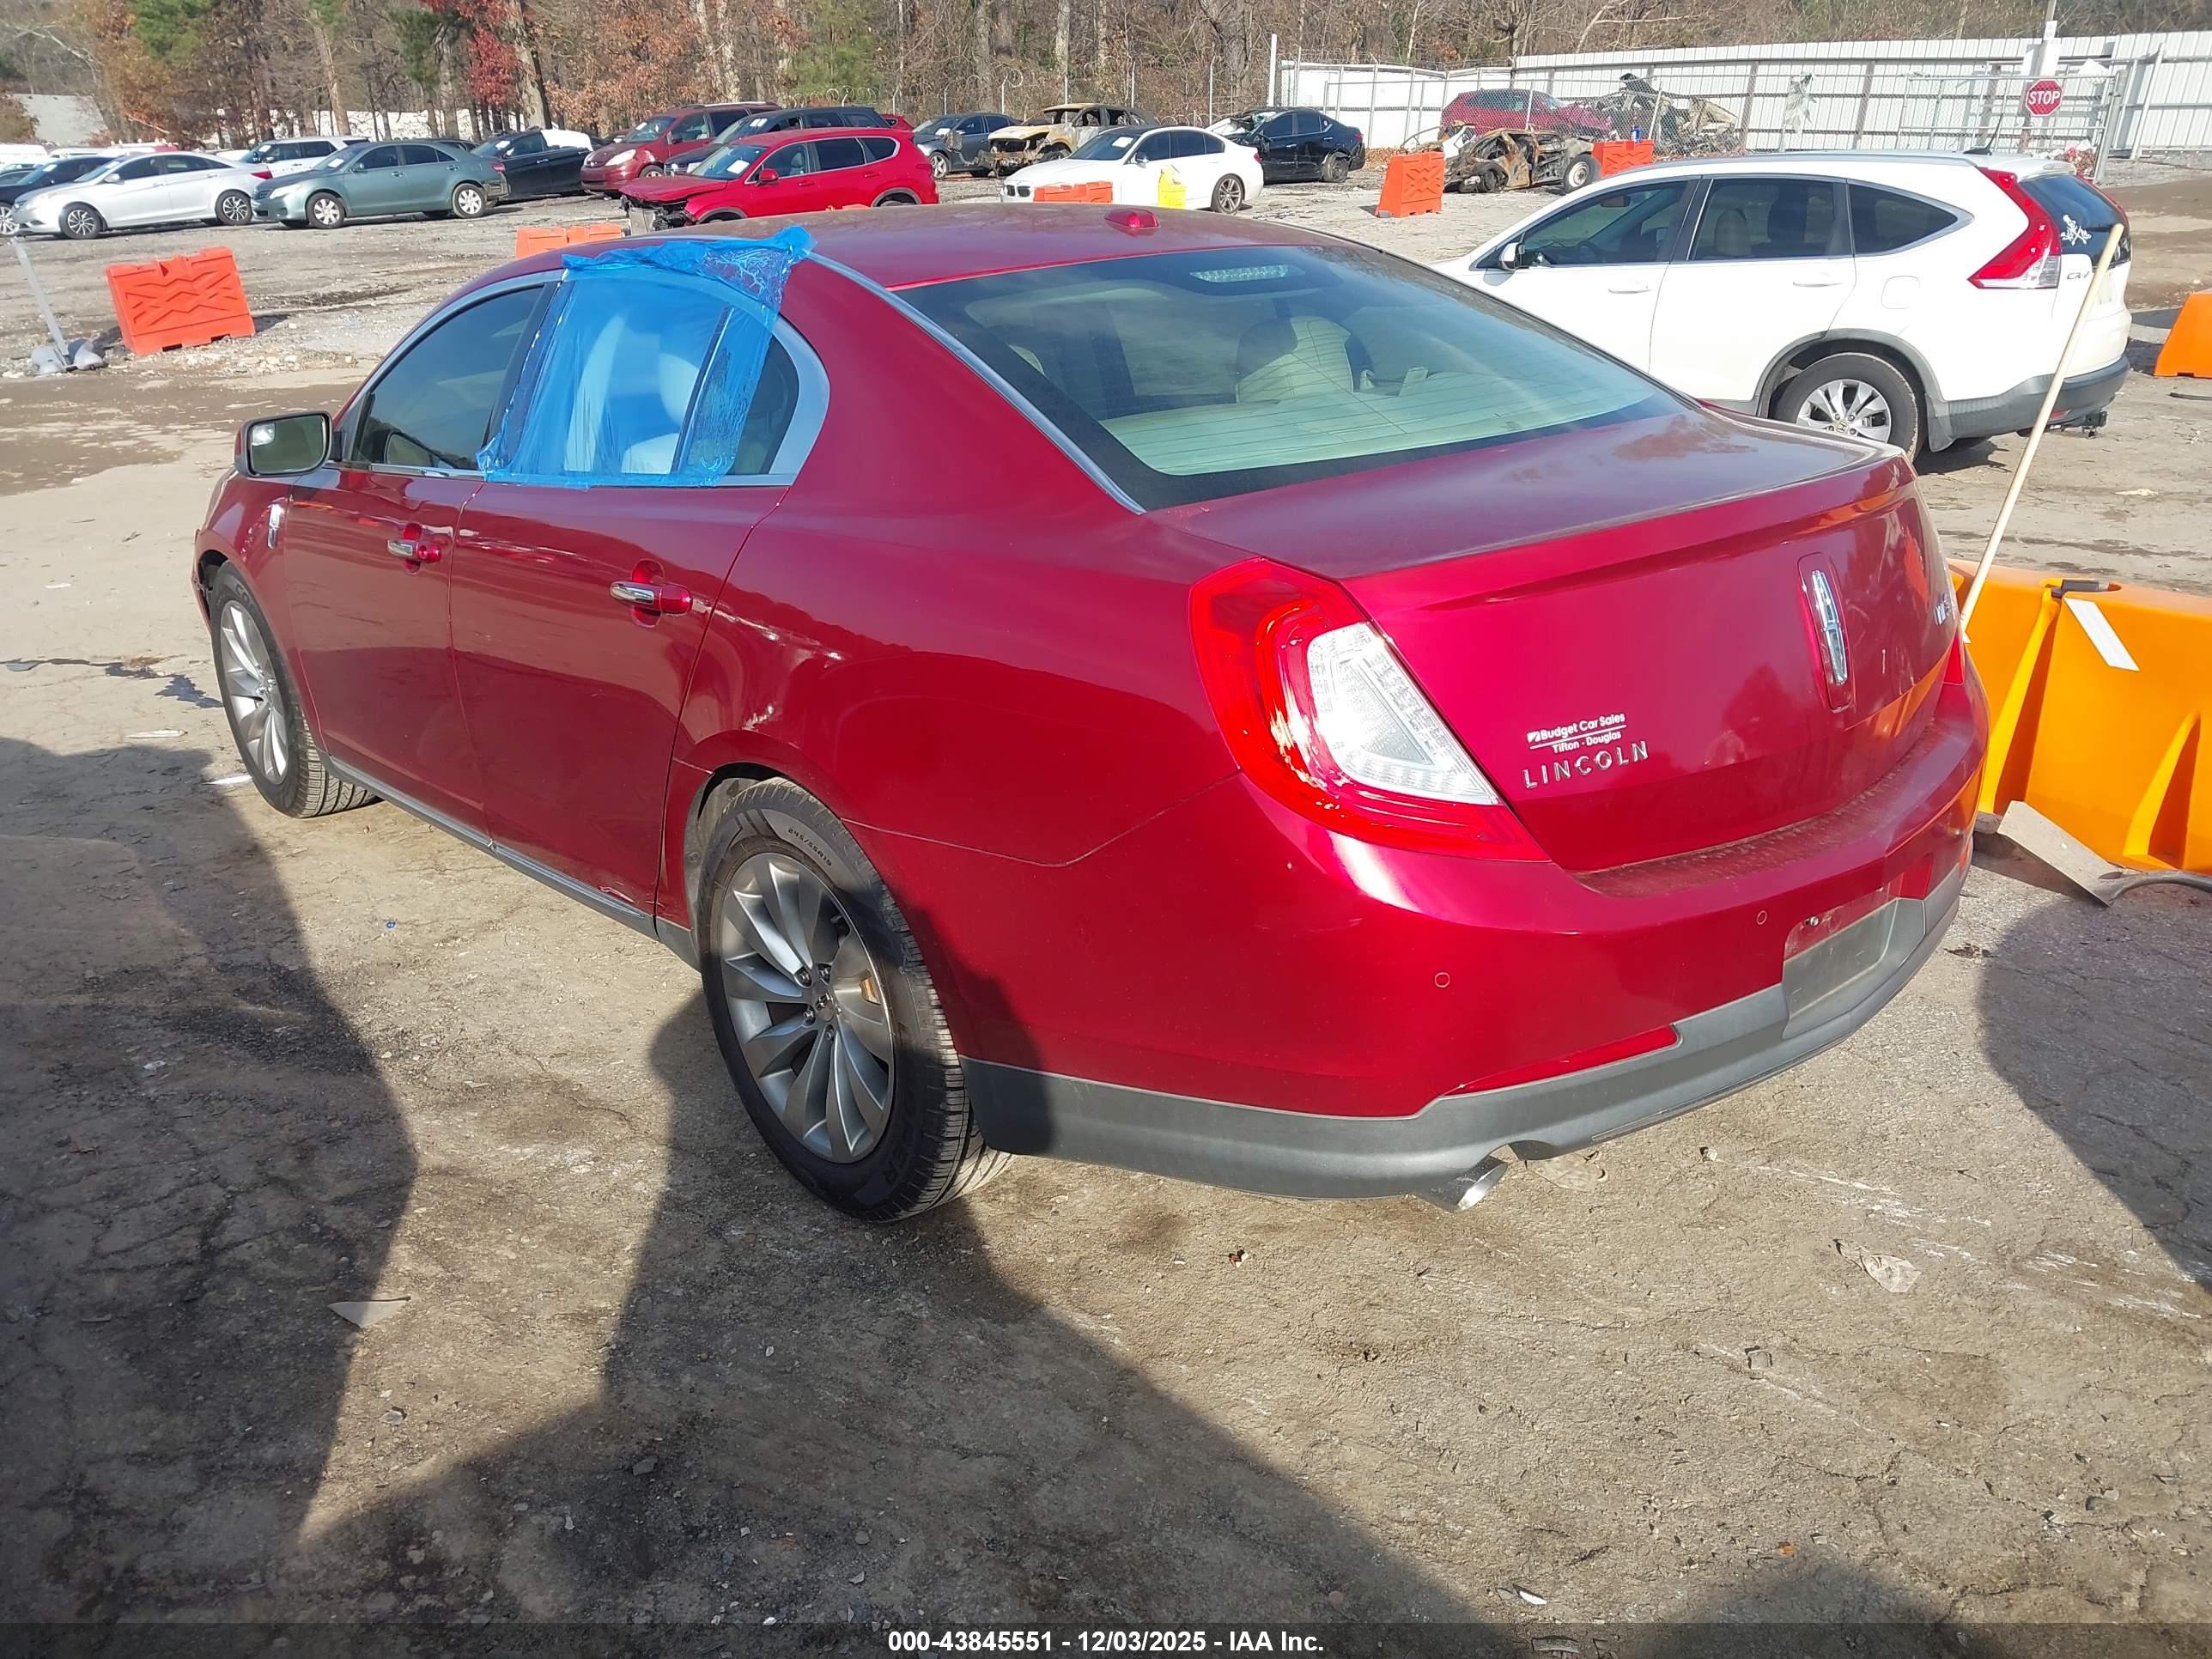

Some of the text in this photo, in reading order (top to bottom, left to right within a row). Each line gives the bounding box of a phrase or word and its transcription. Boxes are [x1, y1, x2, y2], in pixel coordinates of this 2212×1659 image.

[2028, 90, 2060, 105] STOP
[1540, 714, 1626, 742] Budget Car Sales
[1553, 731, 1622, 753] Tifton Douglas
[1522, 741, 1649, 789] LINCOLN
